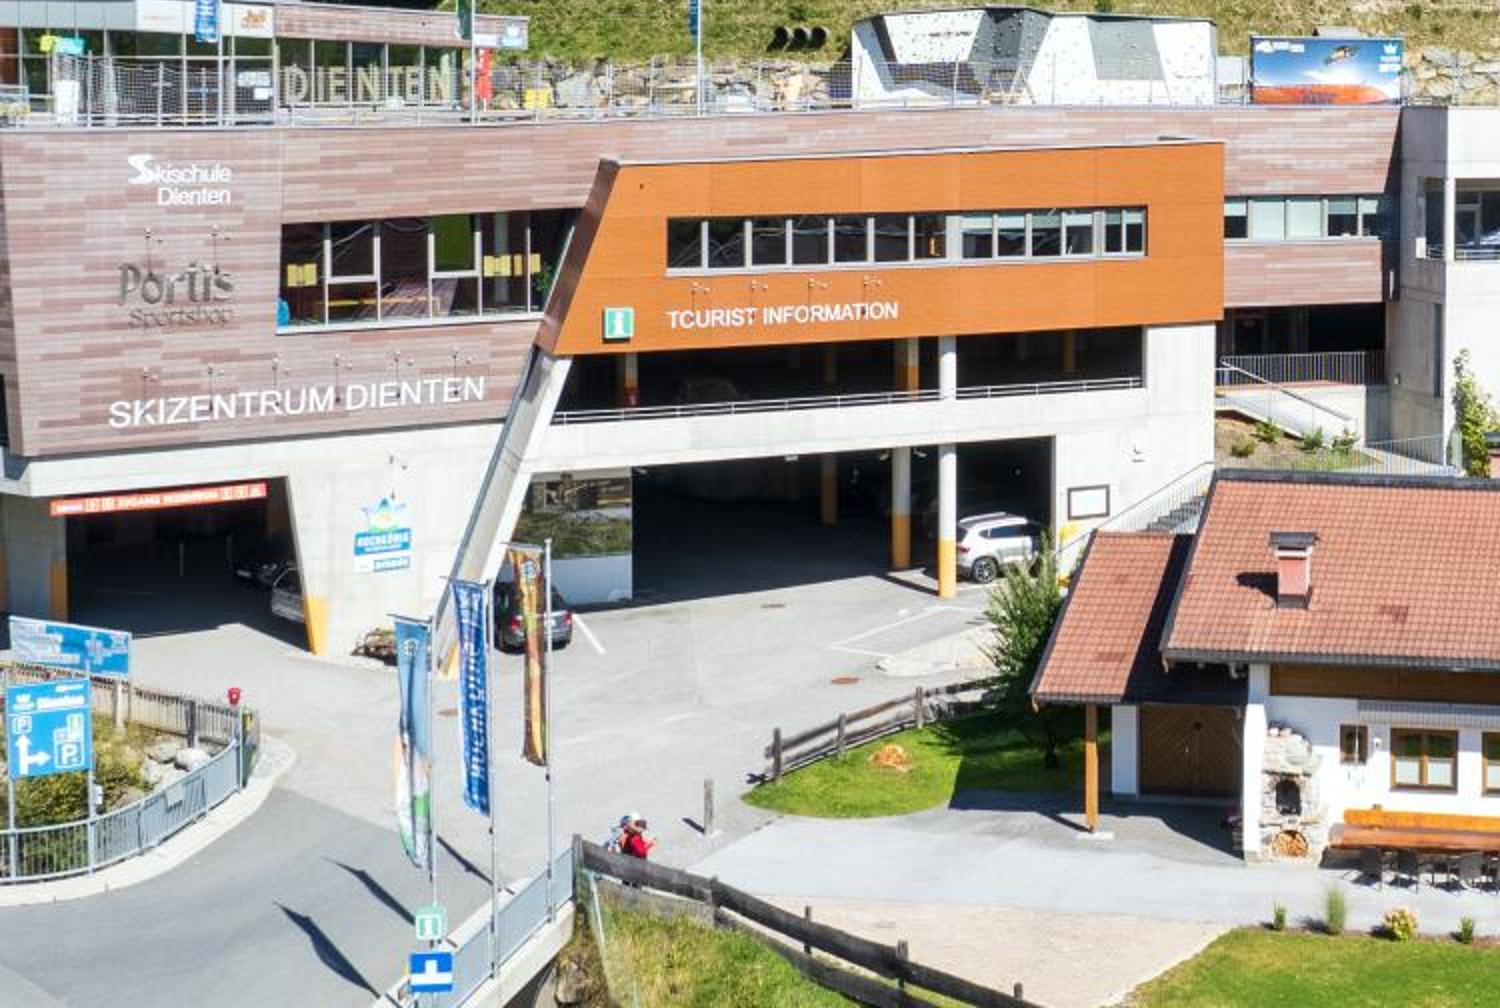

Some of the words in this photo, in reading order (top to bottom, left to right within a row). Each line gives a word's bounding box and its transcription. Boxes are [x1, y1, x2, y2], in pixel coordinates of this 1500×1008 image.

[284, 66, 449, 103] DIENTEN
[127, 153, 233, 184] Skischule
[157, 186, 231, 206] Dienten
[665, 307, 758, 329] TOURIST
[763, 302, 899, 326] INFORMATION
[108, 386, 334, 428] SKIZENTRUM
[345, 375, 486, 410] DIENTEN
